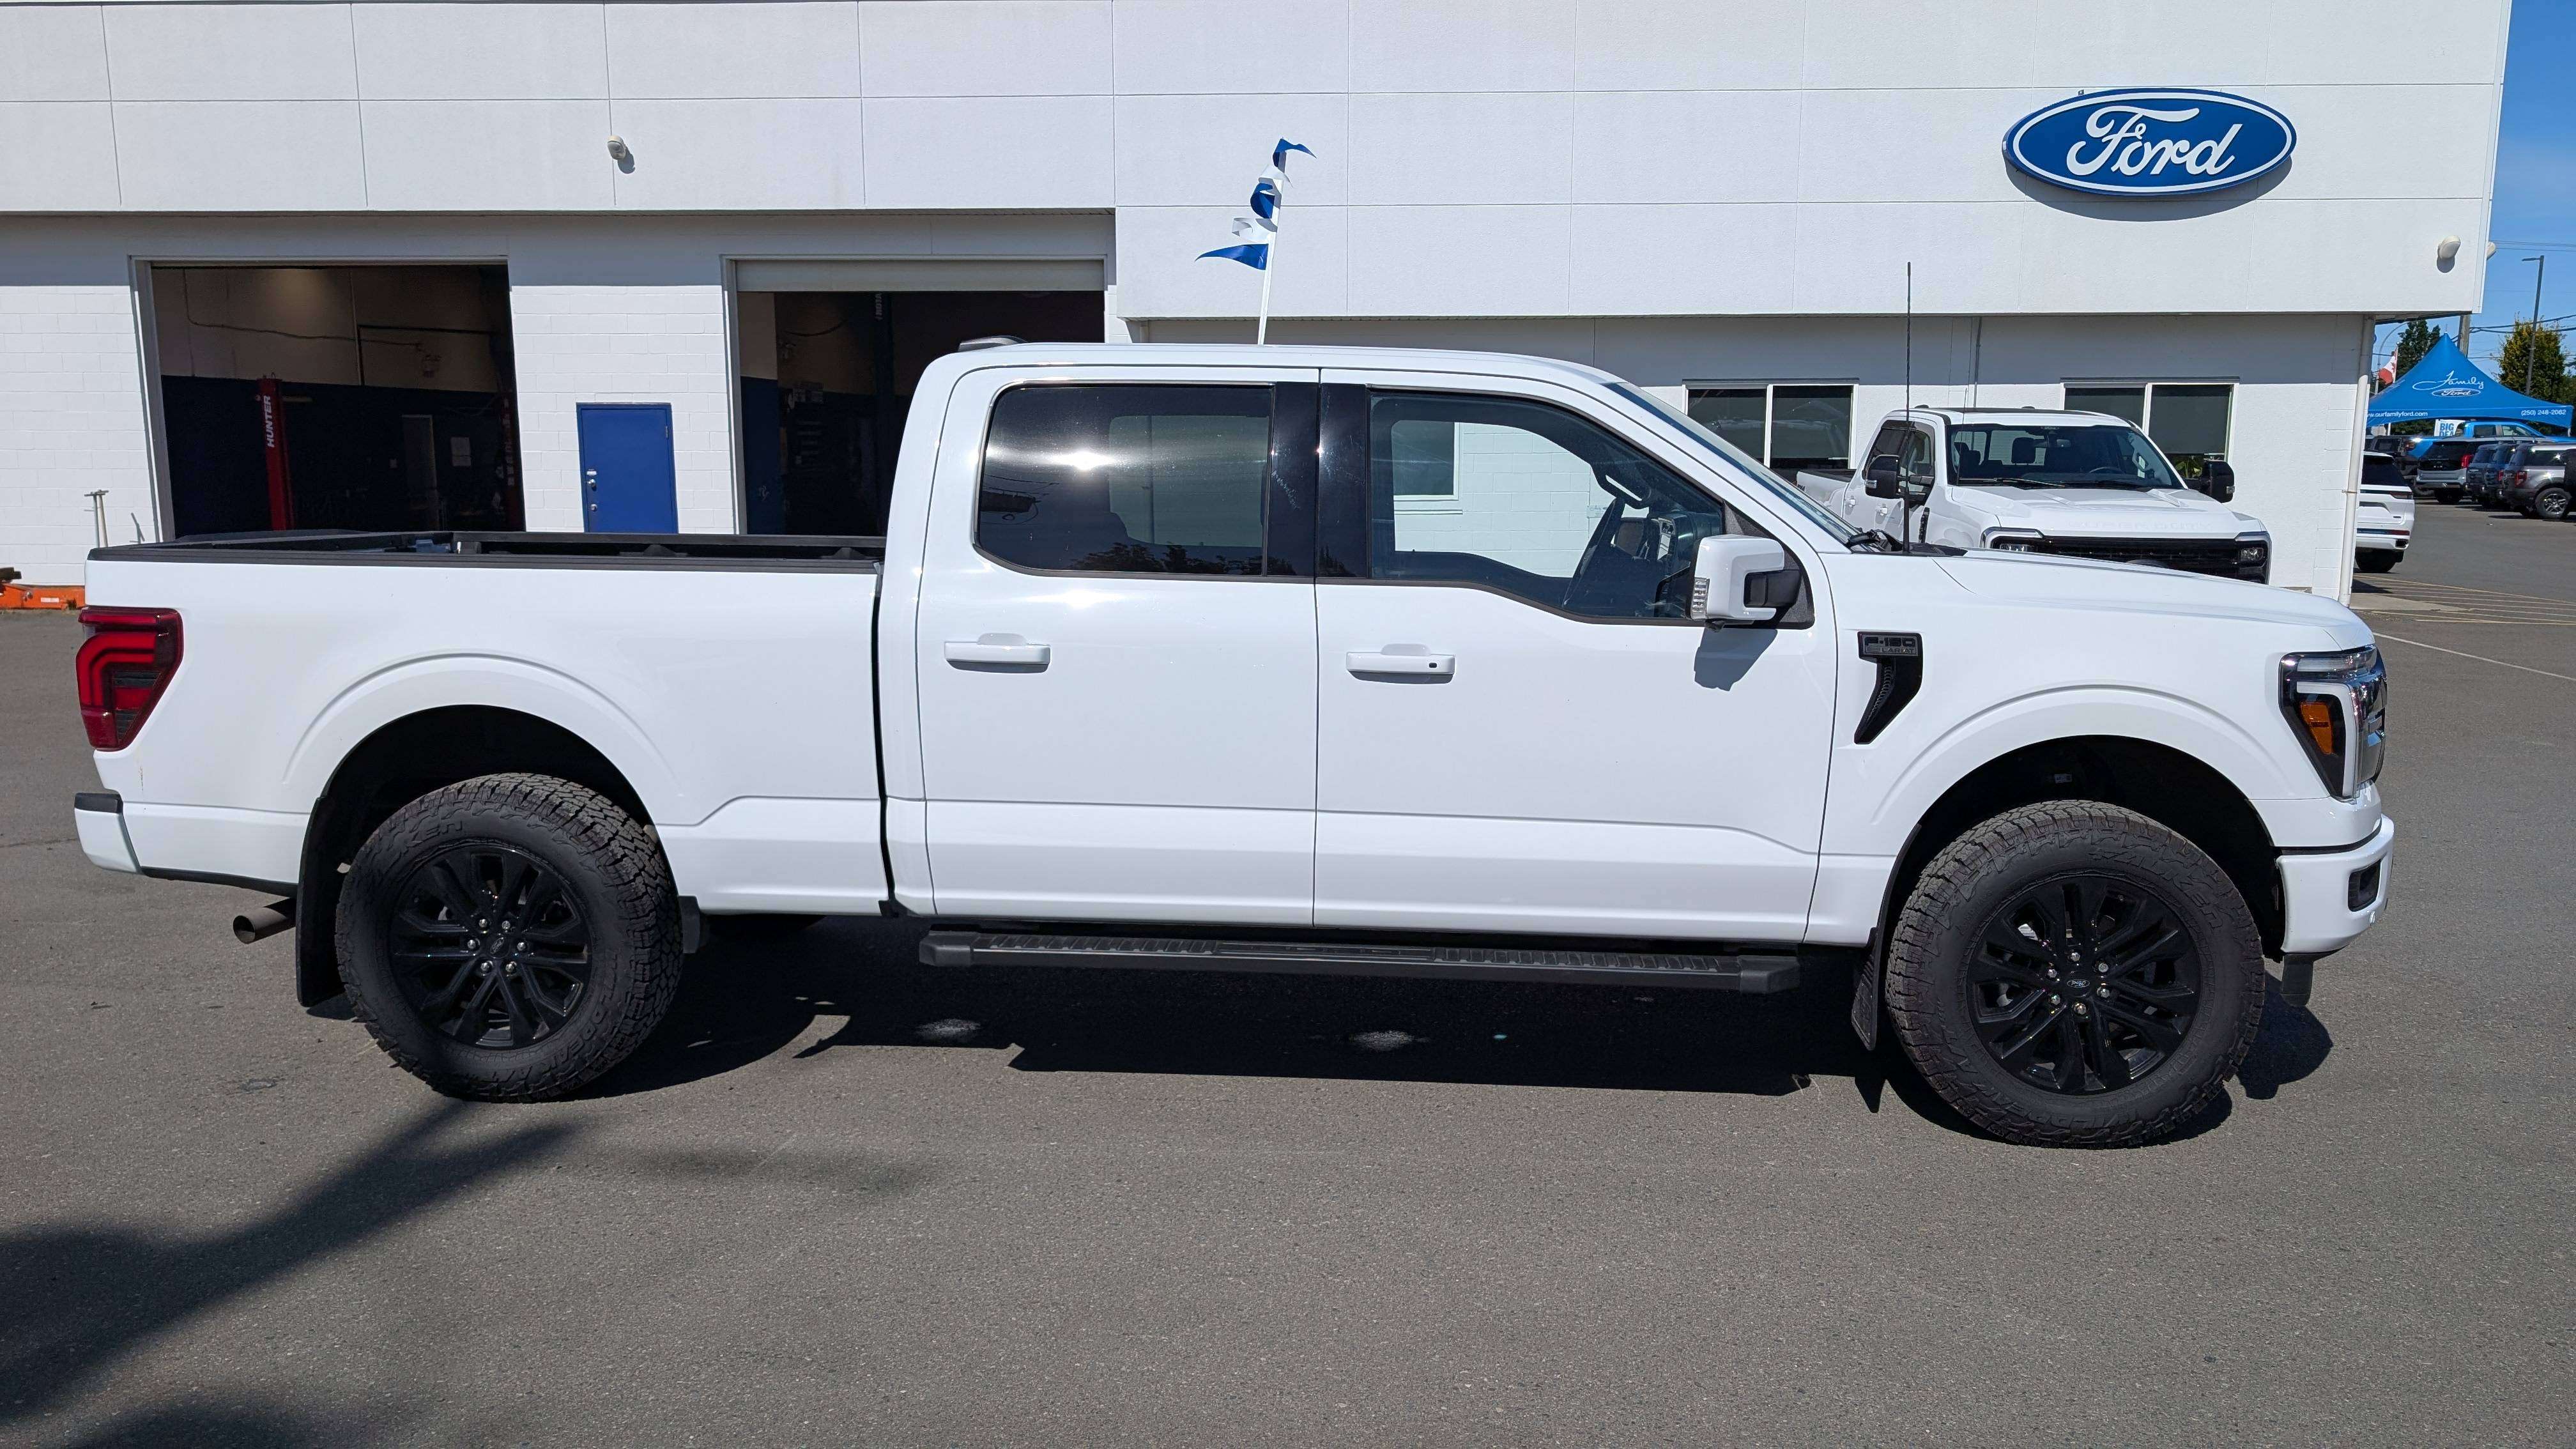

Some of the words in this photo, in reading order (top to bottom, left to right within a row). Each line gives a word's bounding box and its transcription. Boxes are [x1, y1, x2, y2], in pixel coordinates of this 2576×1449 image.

[2066, 105, 2242, 176] Ford
[2412, 370, 2483, 390] Family
[264, 395, 275, 448] HUNTER
[2440, 422, 2454, 431] BIG
[1864, 636, 1917, 647] F-150
